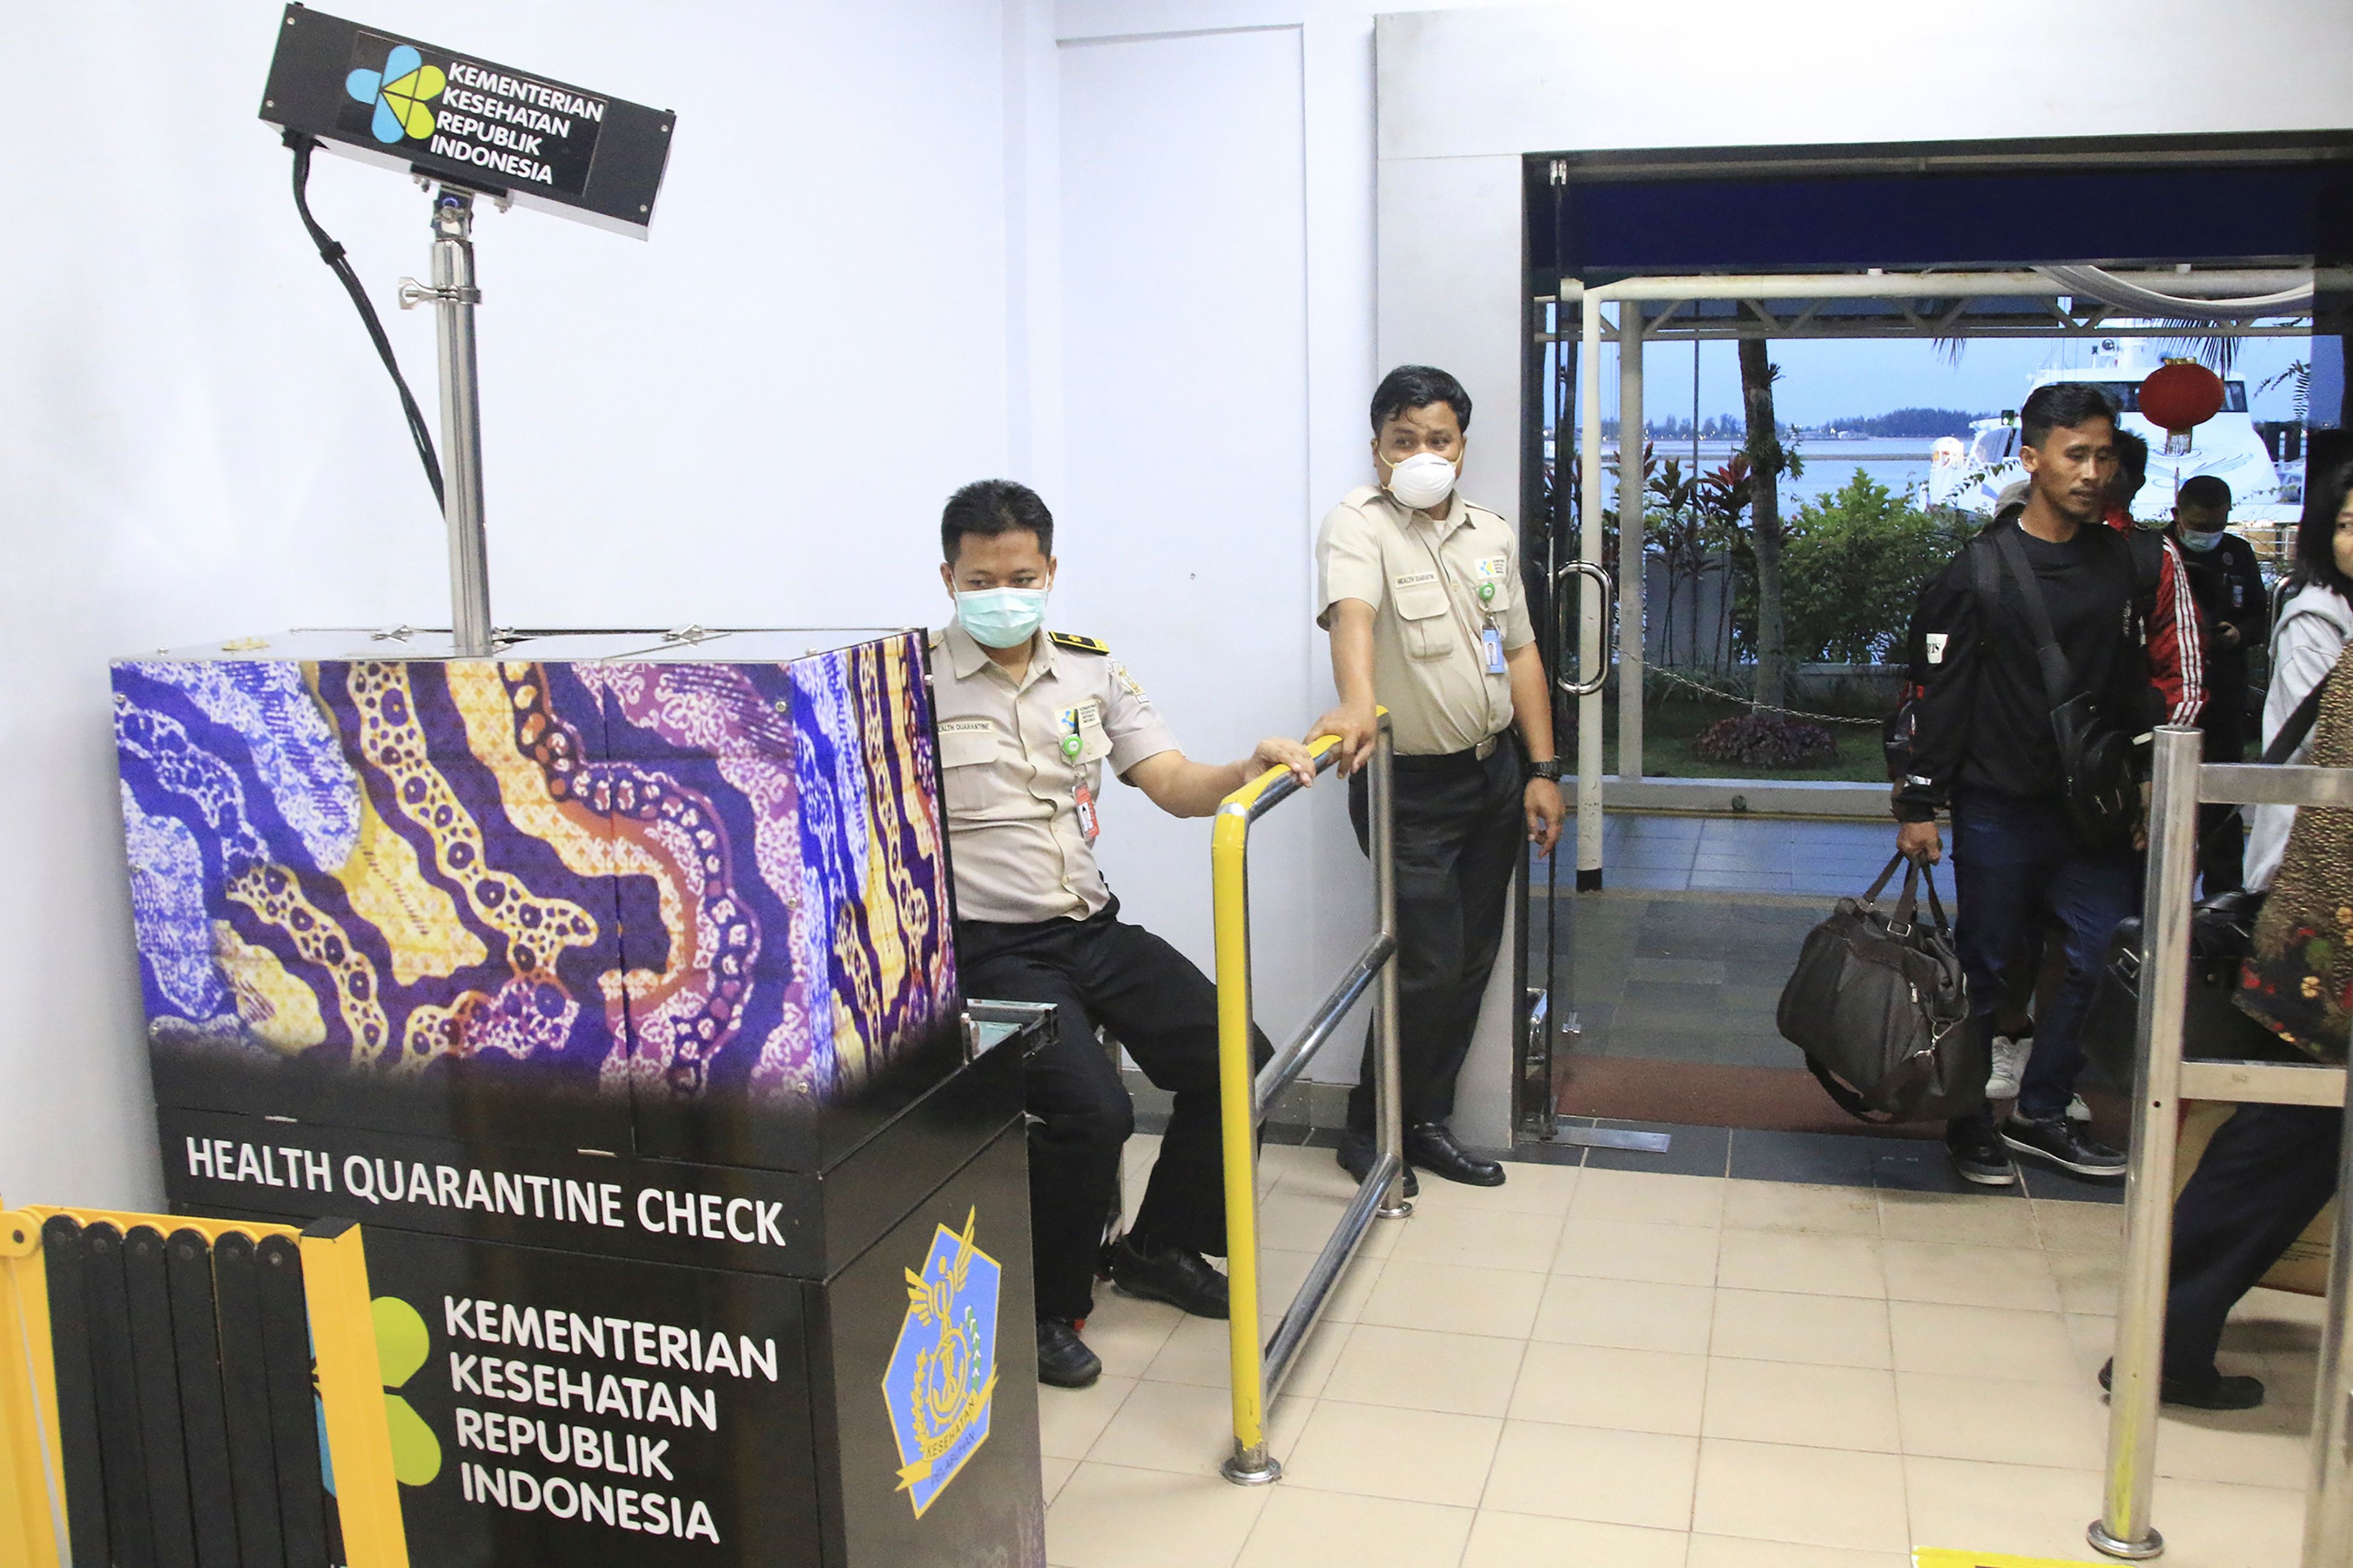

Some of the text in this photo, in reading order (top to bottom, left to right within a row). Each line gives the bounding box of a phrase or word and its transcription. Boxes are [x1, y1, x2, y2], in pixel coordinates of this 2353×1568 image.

[442, 86, 571, 138] KESEHATAN
[448, 62, 604, 122] KEMENTERIAN
[430, 135, 552, 185] INDONESIA
[436, 110, 542, 156] REPUBLIK
[938, 723, 954, 732] EALTH
[186, 1136, 787, 1246] HEALTH QUARANTINE CHECK
[444, 1295, 778, 1382] KEMENTERIAN
[450, 1351, 717, 1431] KESEHATAN
[456, 1408, 674, 1481] REPUBLIK
[926, 1397, 976, 1459] KESEHATAN
[462, 1462, 720, 1544] INDONESIA
